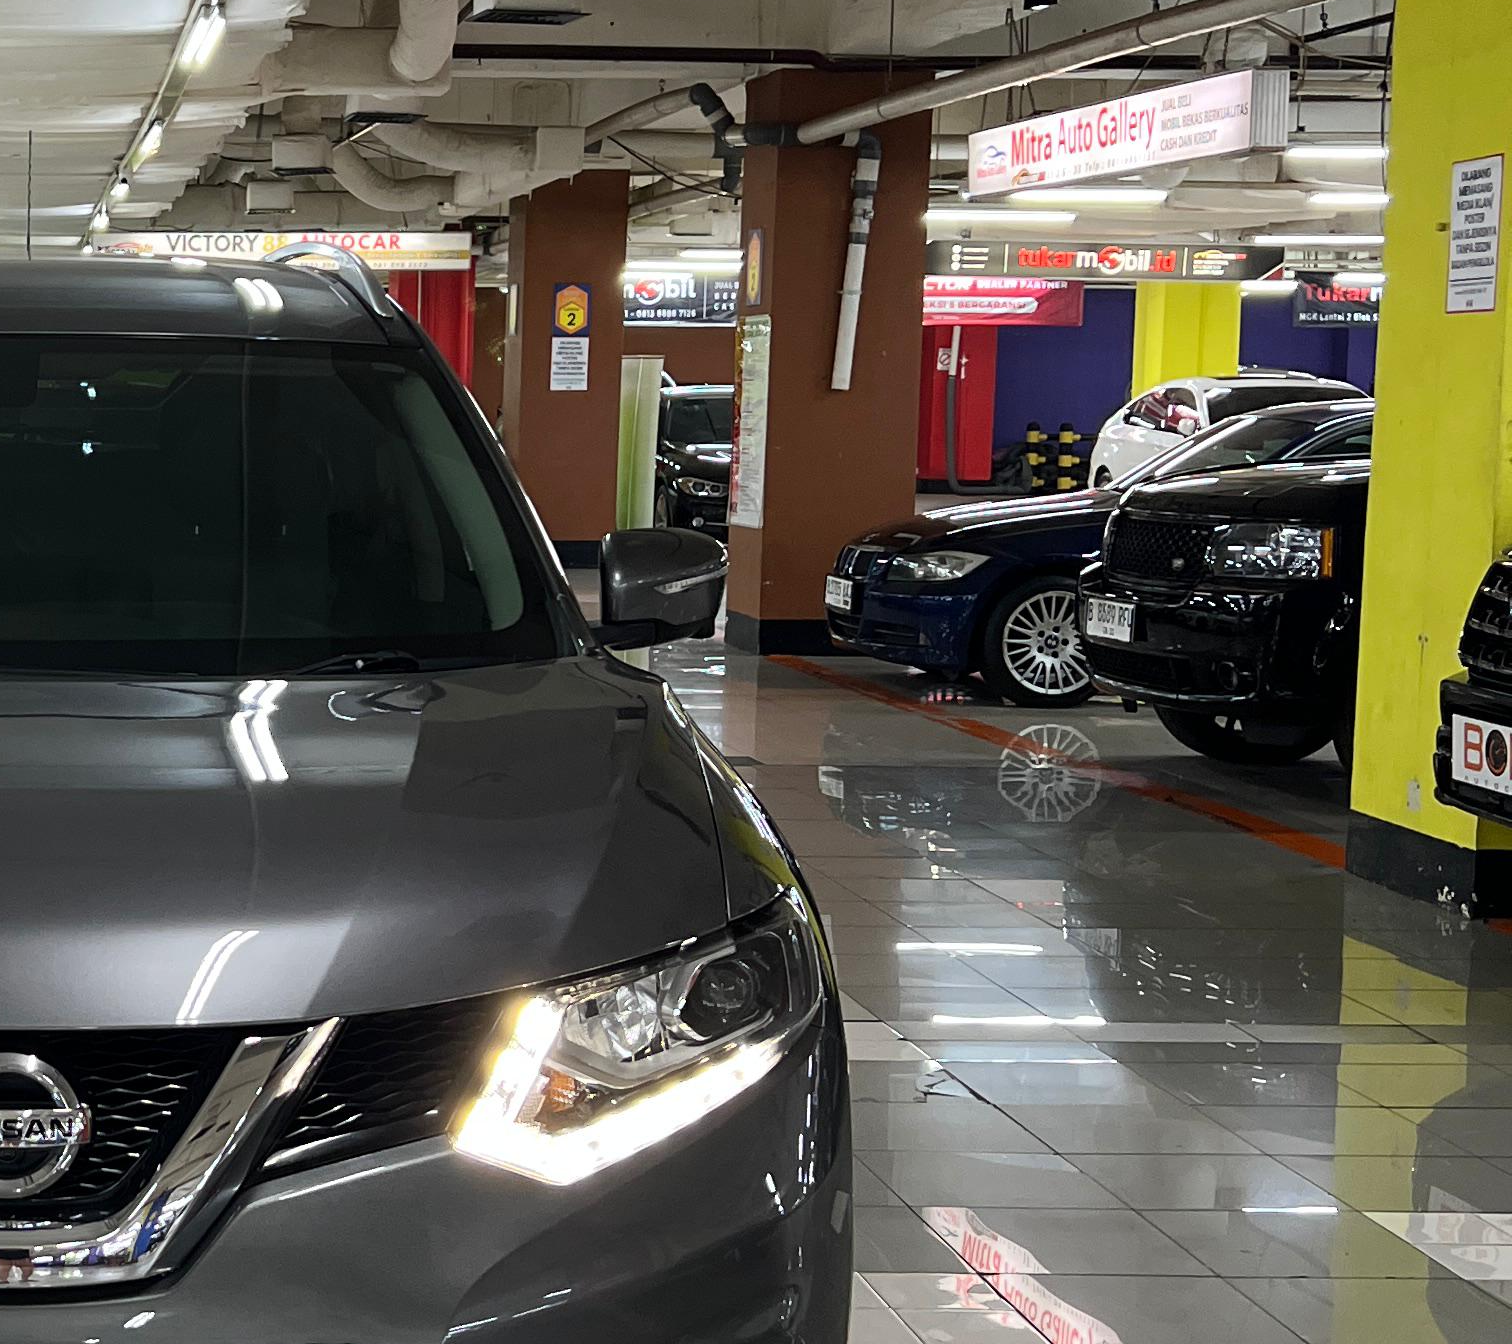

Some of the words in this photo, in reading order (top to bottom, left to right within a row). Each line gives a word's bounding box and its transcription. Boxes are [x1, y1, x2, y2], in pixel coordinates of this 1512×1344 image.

[1011, 126, 1052, 168] Mitra
[1058, 116, 1093, 154] Auto
[1097, 100, 1156, 151] Gallery
[166, 234, 259, 253] VICTORY
[567, 312, 576, 326] 2
